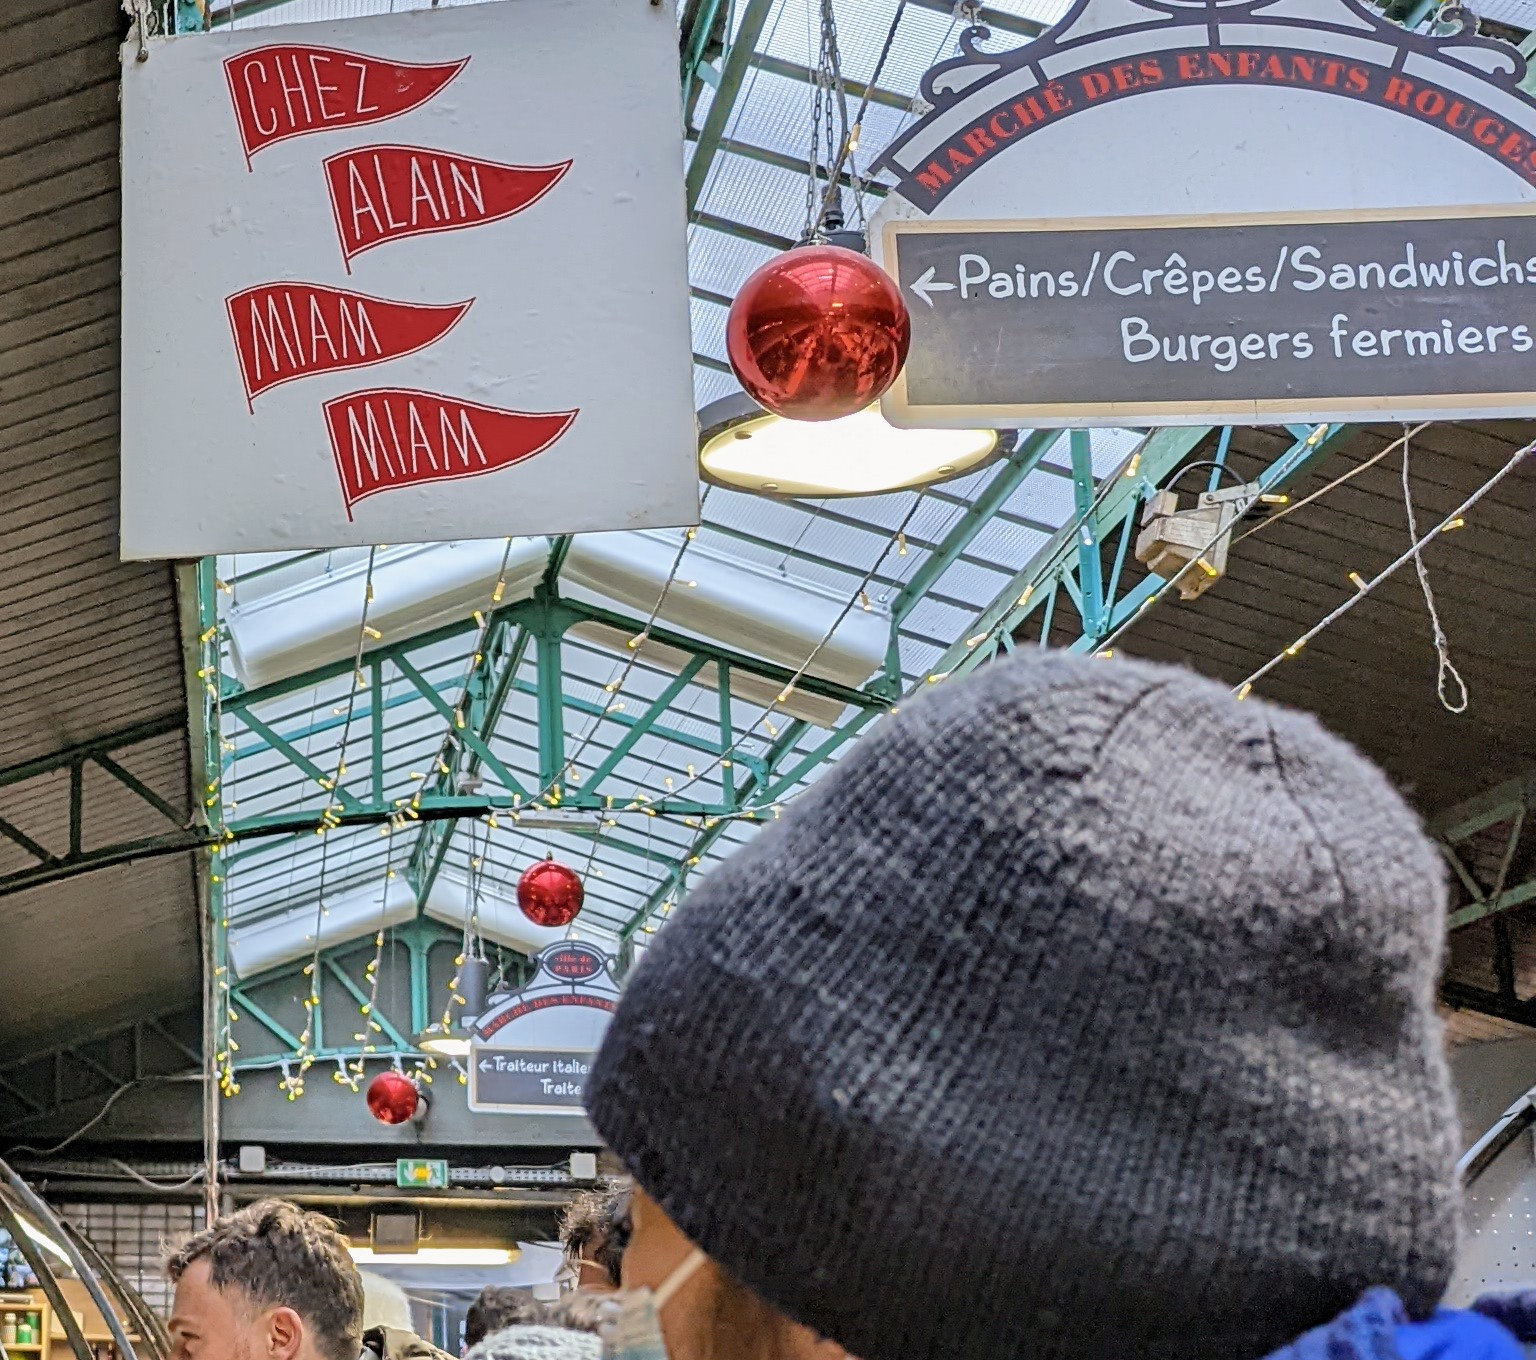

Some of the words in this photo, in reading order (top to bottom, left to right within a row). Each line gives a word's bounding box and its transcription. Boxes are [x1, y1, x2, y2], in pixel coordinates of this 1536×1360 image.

[243, 55, 381, 136] CHEZ
[914, 79, 1074, 198] MARCHÉ
[1081, 56, 1166, 102] DES
[1176, 50, 1372, 94] ENFANTS
[347, 157, 487, 242] ALAIN
[248, 292, 382, 381] MIAM
[1121, 315, 1315, 372] Burgers
[1330, 313, 1534, 359] fermiers
[346, 399, 487, 489] MIAM
[492, 1055, 551, 1073] Traiteur
[540, 1078, 583, 1096] Traite
